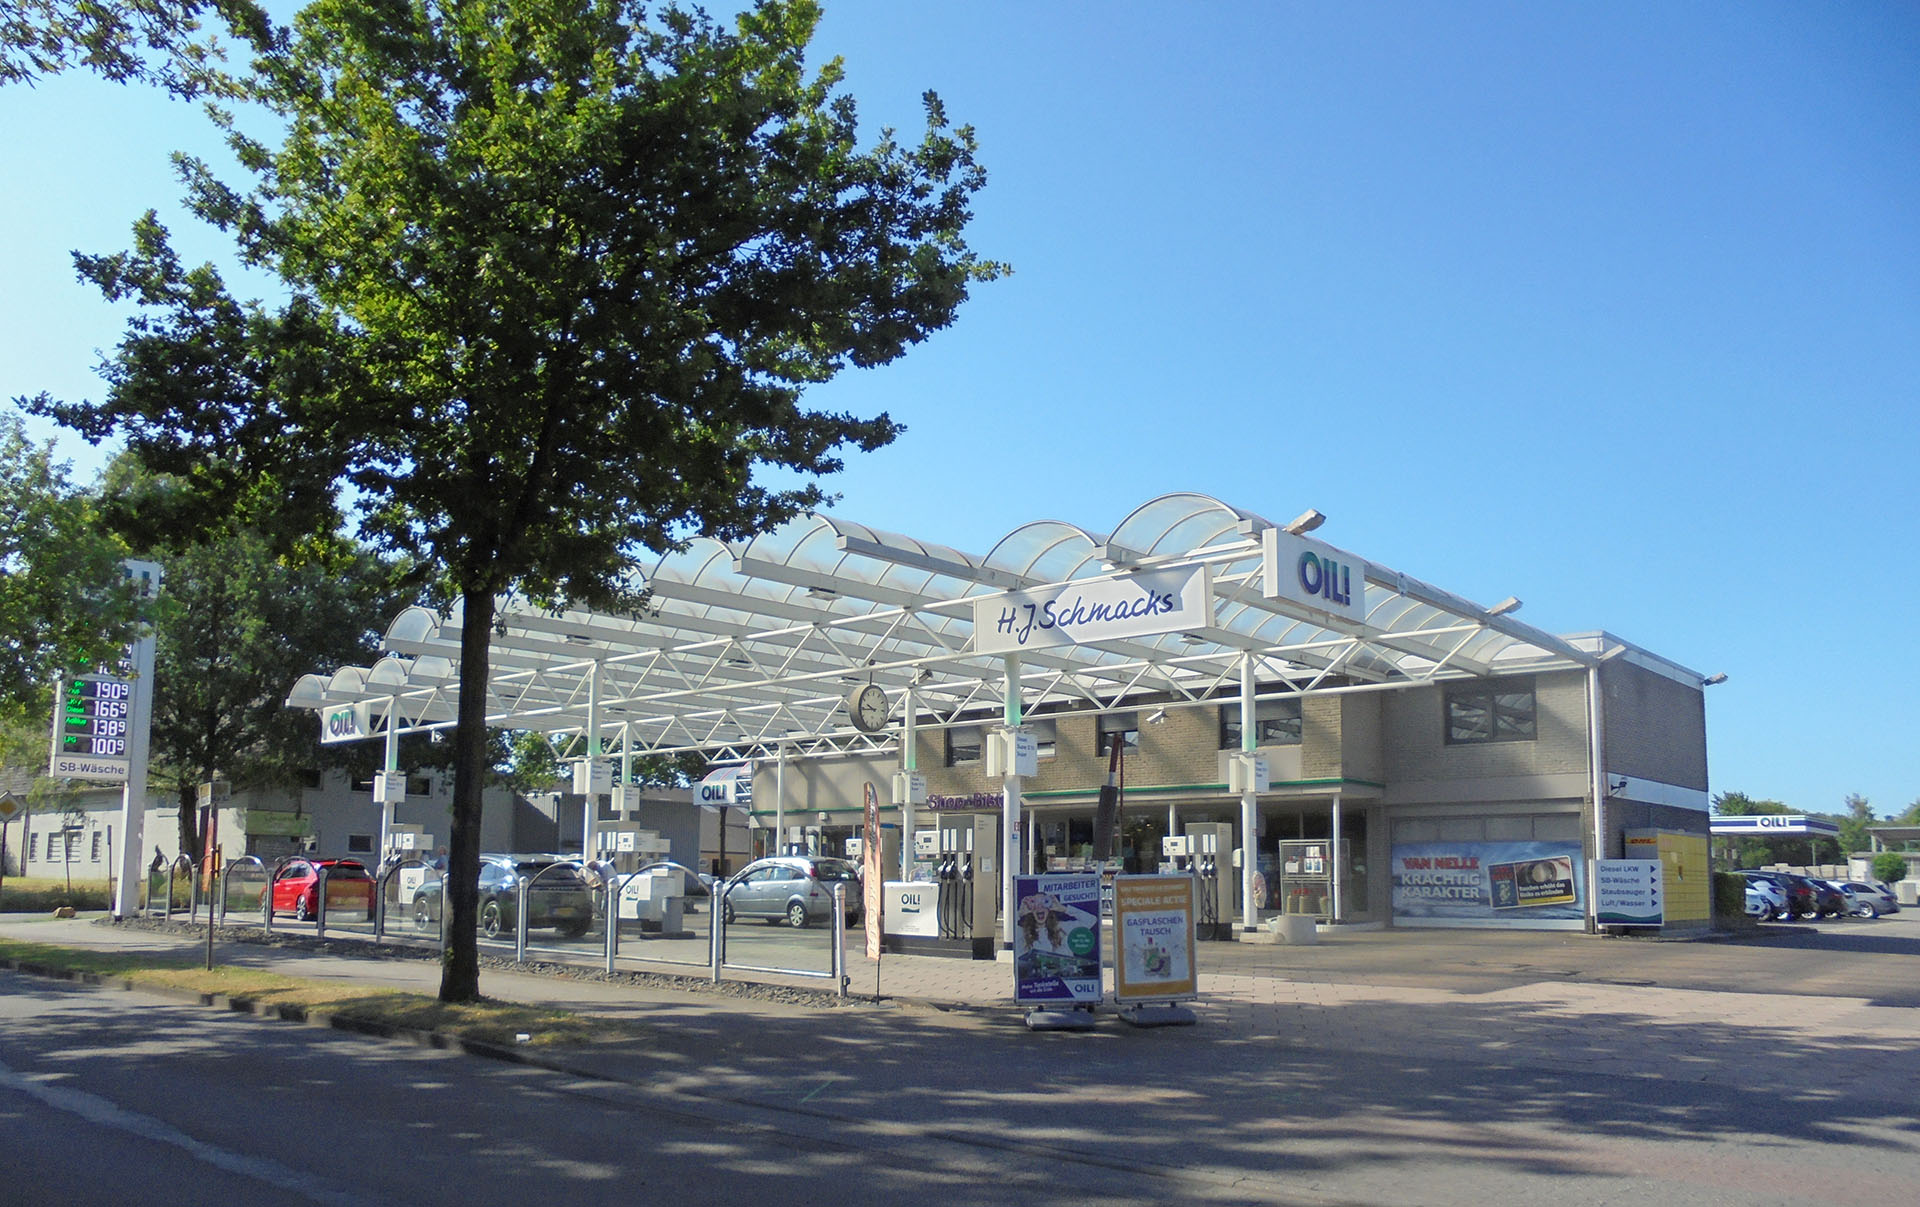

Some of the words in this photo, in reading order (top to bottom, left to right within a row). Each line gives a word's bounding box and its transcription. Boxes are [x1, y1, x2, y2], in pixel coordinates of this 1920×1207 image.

[1297, 551, 1350, 607] OIL!
[96, 681, 129, 699] 1909
[94, 700, 127, 718] 1669
[93, 719, 126, 736] 1389
[91, 738, 125, 755] 1009
[59, 762, 125, 775] SB-Wäsche
[702, 784, 727, 801] OIL!
[1760, 816, 1787, 828] OIL!
[1600, 865, 1622, 873] Diesel
[1623, 865, 1640, 873] LKW
[1401, 873, 1481, 885] KRACHTIG
[1043, 879, 1096, 893] MITARBEITER
[1600, 888, 1646, 896] Staubsauger
[1401, 886, 1480, 899] KARAKTER
[901, 893, 921, 905] OIL!
[1121, 895, 1161, 907] SPECIALE
[1126, 916, 1184, 927] GASFLASCHEN
[1140, 927, 1172, 936] TAUSCH
[1074, 983, 1095, 993] OIL!
